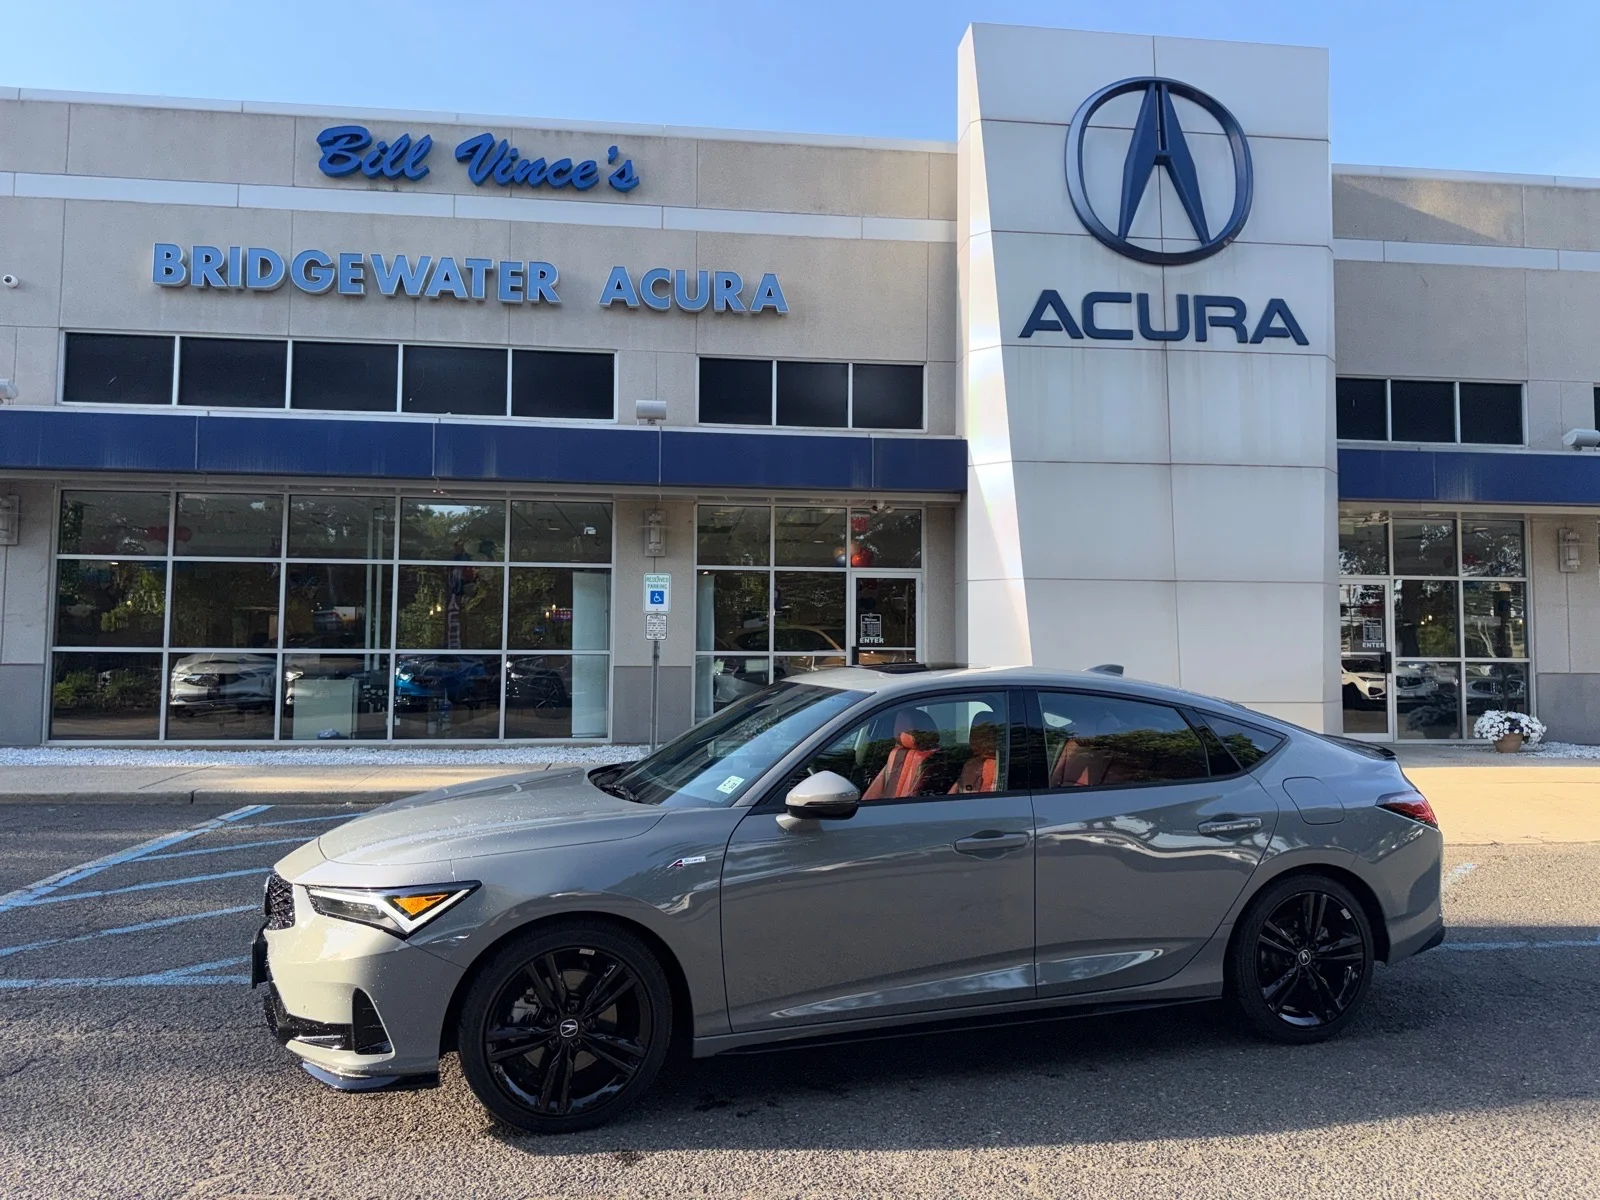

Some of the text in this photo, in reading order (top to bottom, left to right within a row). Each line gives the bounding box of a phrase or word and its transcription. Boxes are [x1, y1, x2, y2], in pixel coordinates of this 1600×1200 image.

[316, 125, 640, 193] Bill Vince's
[151, 242, 789, 315] BRIDGEWATER ACURA
[1018, 289, 1310, 346] ACURA
